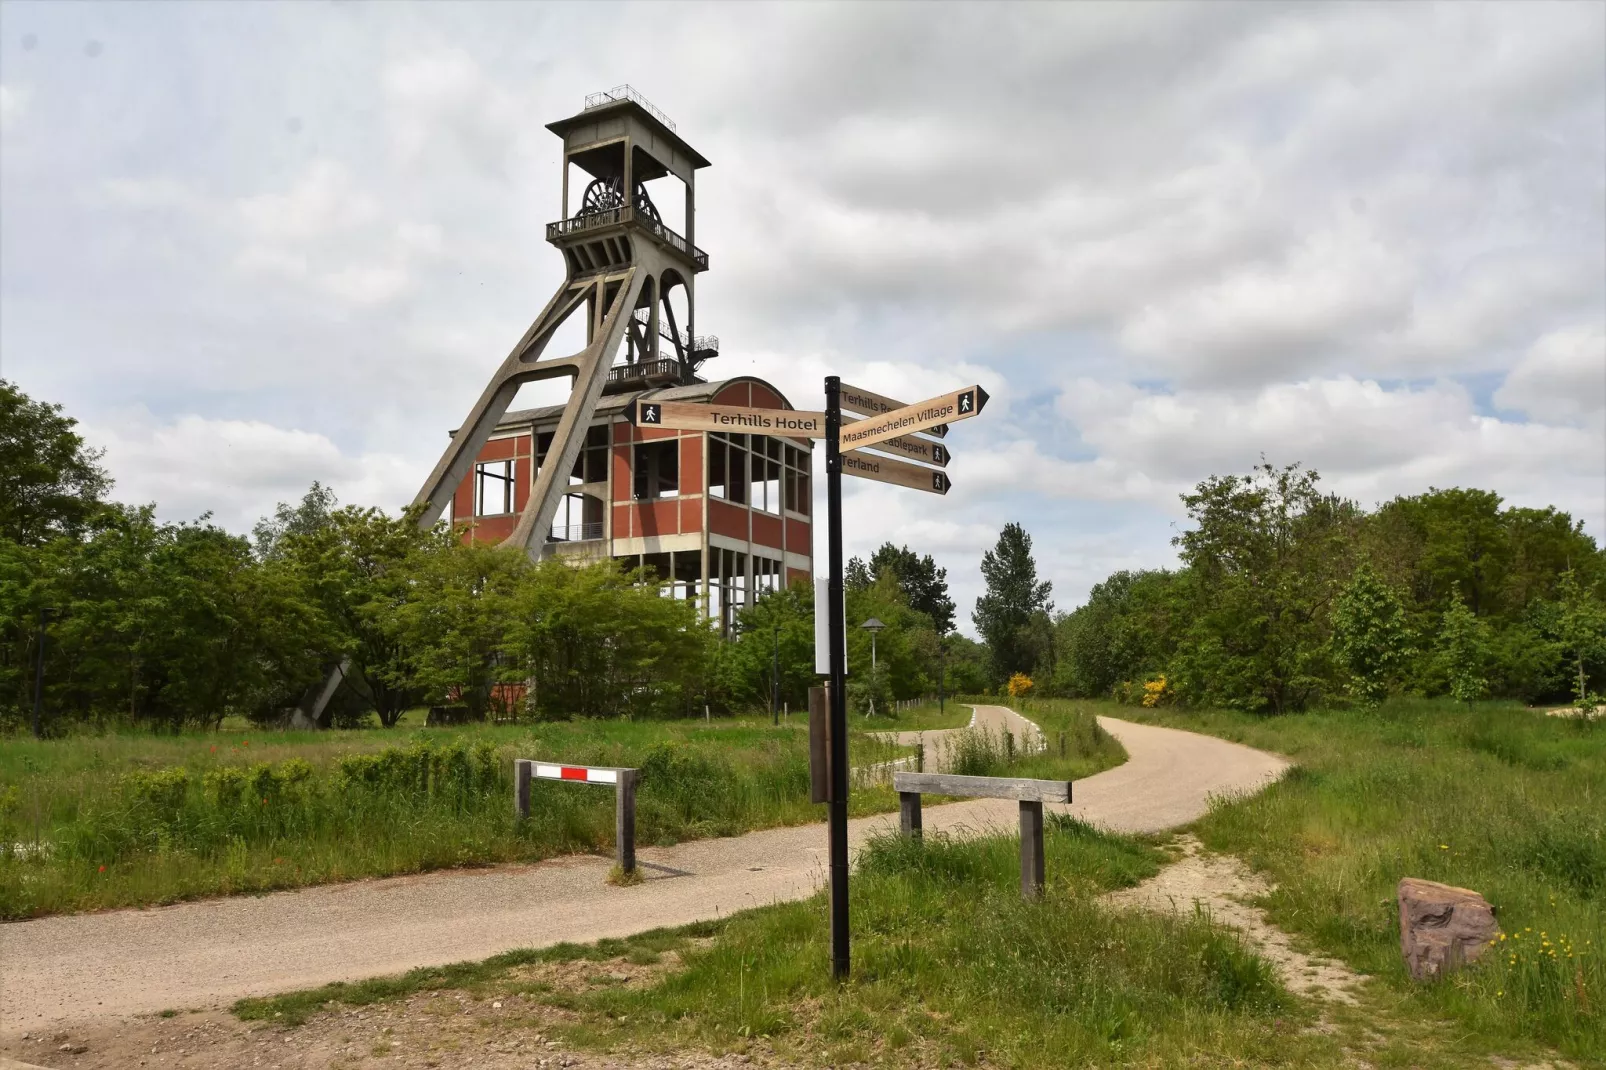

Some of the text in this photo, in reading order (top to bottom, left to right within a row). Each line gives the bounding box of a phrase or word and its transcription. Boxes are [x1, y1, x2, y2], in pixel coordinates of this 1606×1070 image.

[842, 390, 879, 411] Terhills
[710, 412, 817, 430] Terhills Hotel
[842, 404, 953, 444] Maasmechelen Village
[842, 455, 880, 473] Terland
